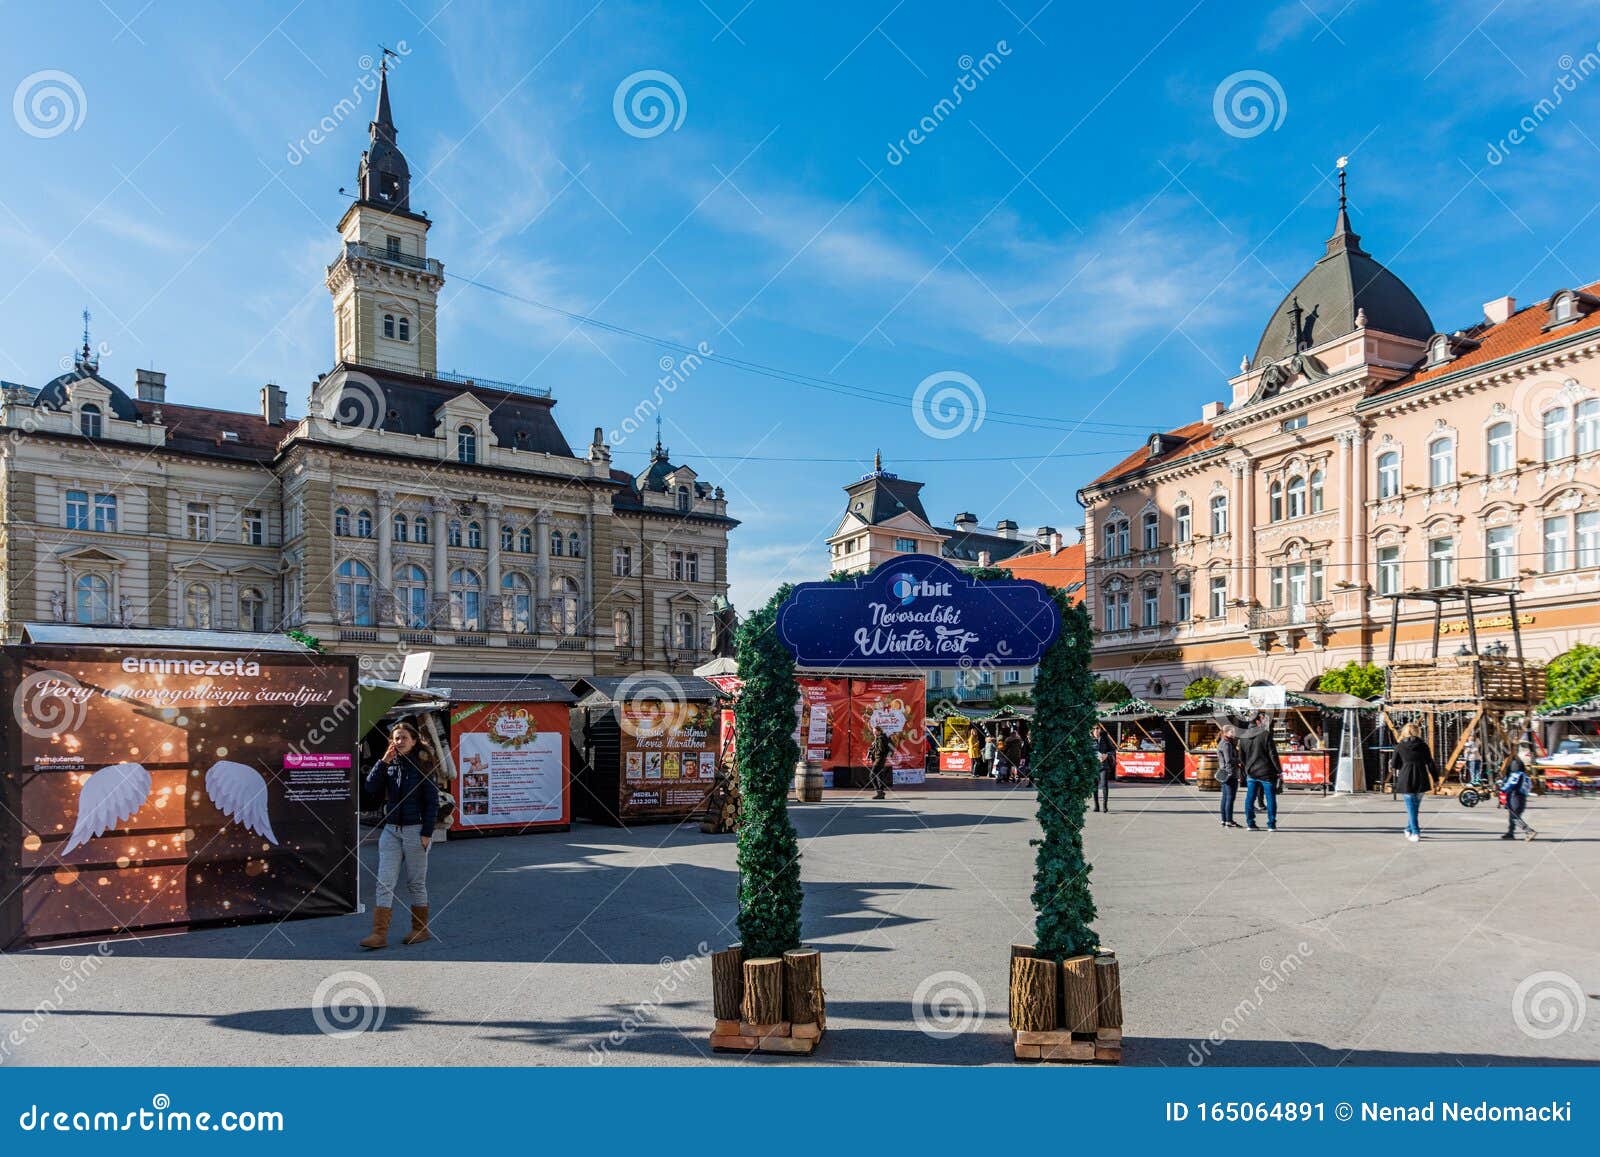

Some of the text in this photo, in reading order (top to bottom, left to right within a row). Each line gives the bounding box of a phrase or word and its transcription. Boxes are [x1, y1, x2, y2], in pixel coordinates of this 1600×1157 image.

[890, 577, 952, 602] Orbit
[868, 602, 961, 627] Novosadski
[854, 627, 935, 656] Winter
[122, 656, 260, 677] emmezeta
[255, 686, 333, 707] čaroliju!
[636, 736, 706, 748] Movie Marathon
